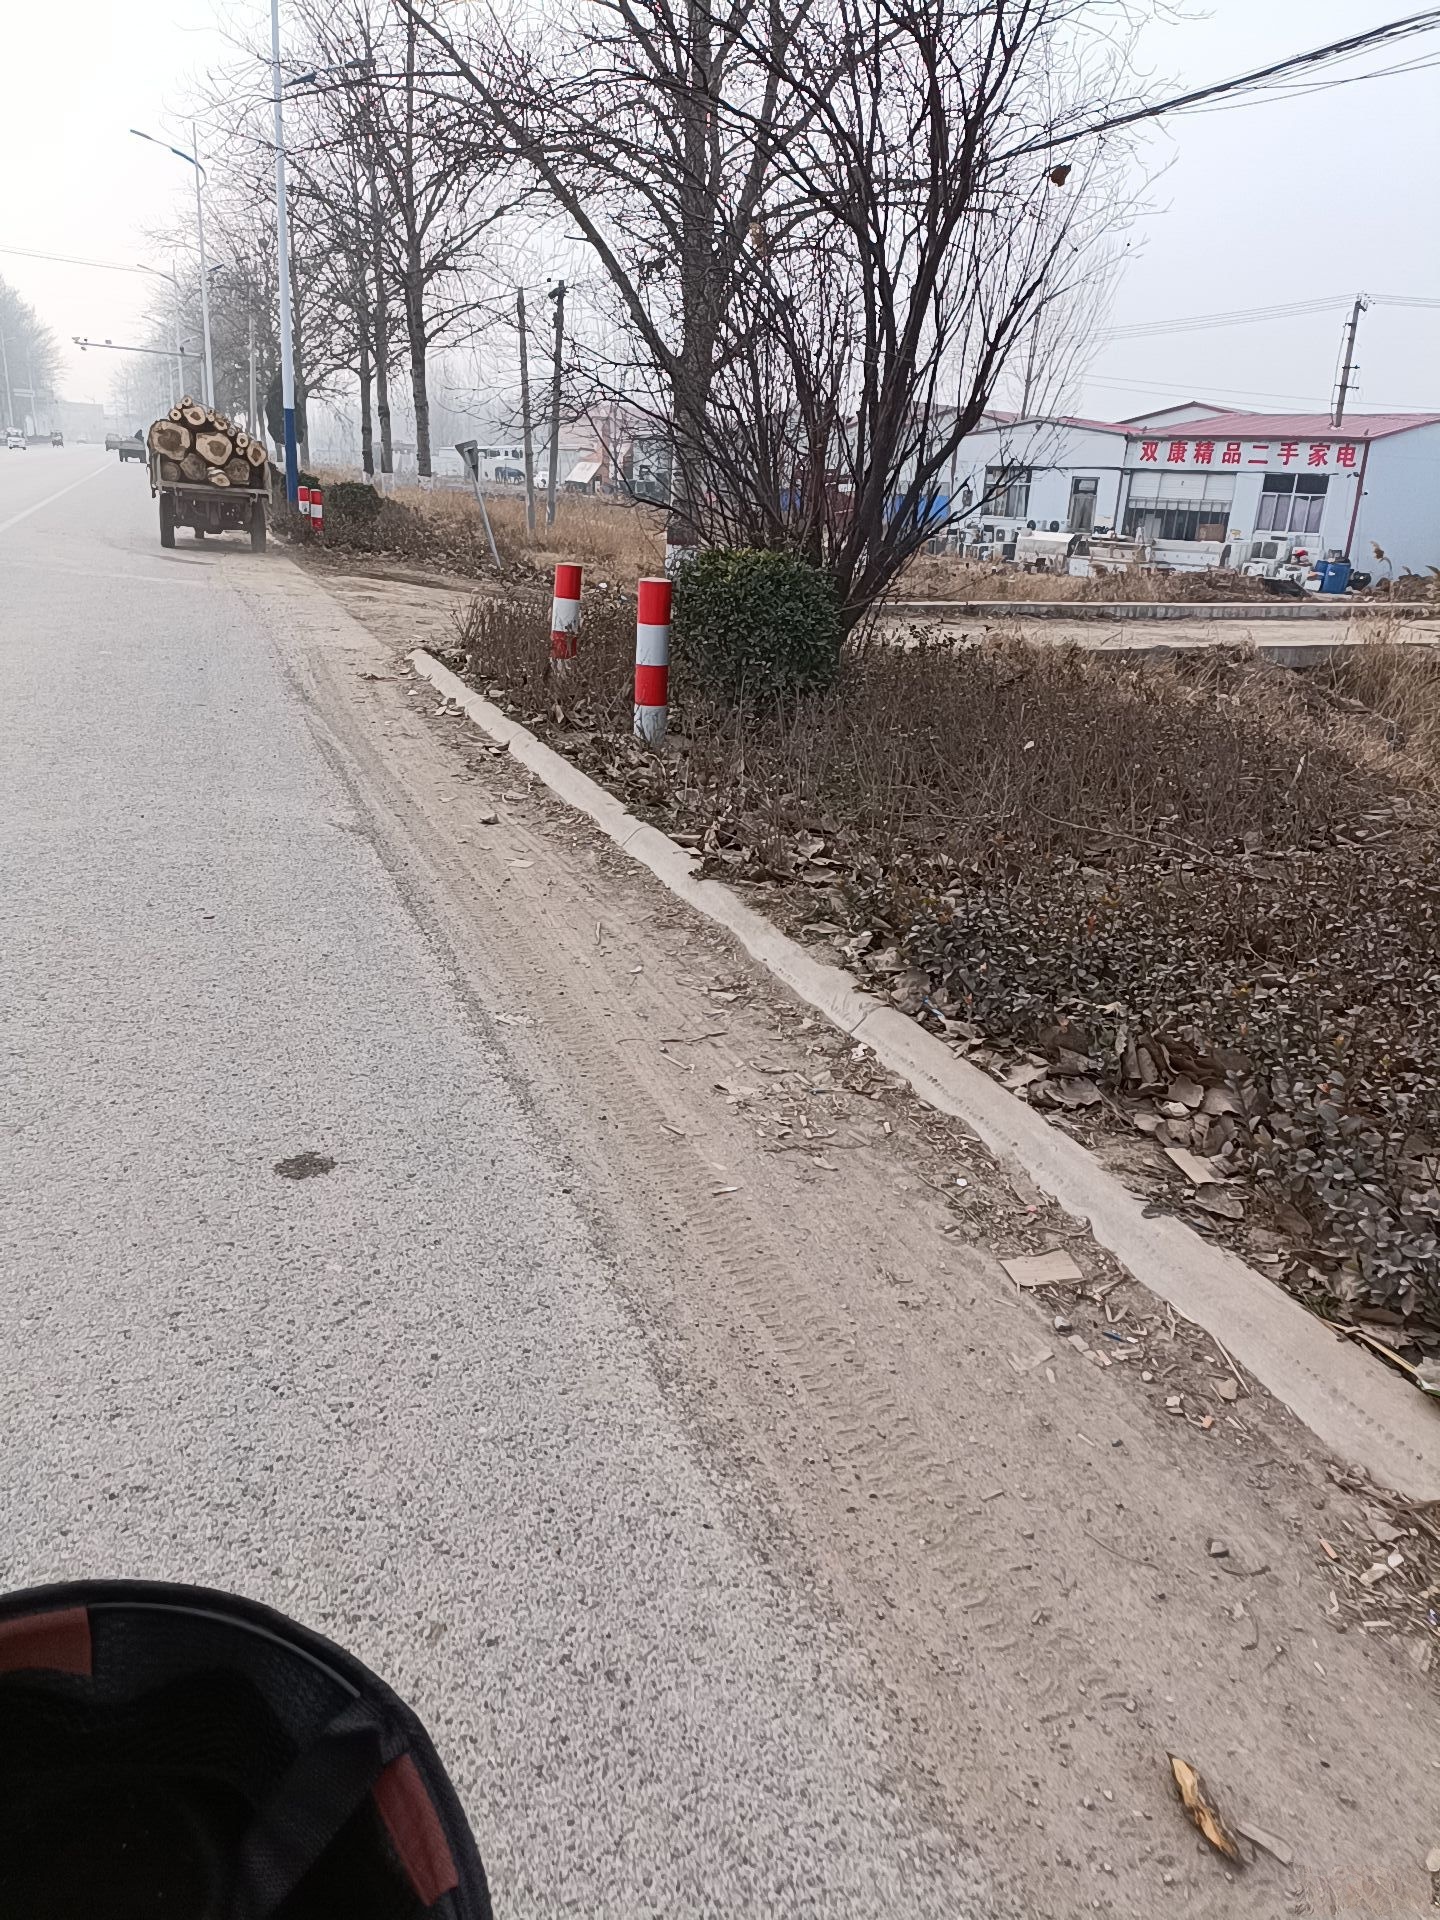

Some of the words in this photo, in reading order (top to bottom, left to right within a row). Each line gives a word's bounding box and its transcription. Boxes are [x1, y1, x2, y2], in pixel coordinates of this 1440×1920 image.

[1140, 441, 1356, 467] 双康精品二手家电
